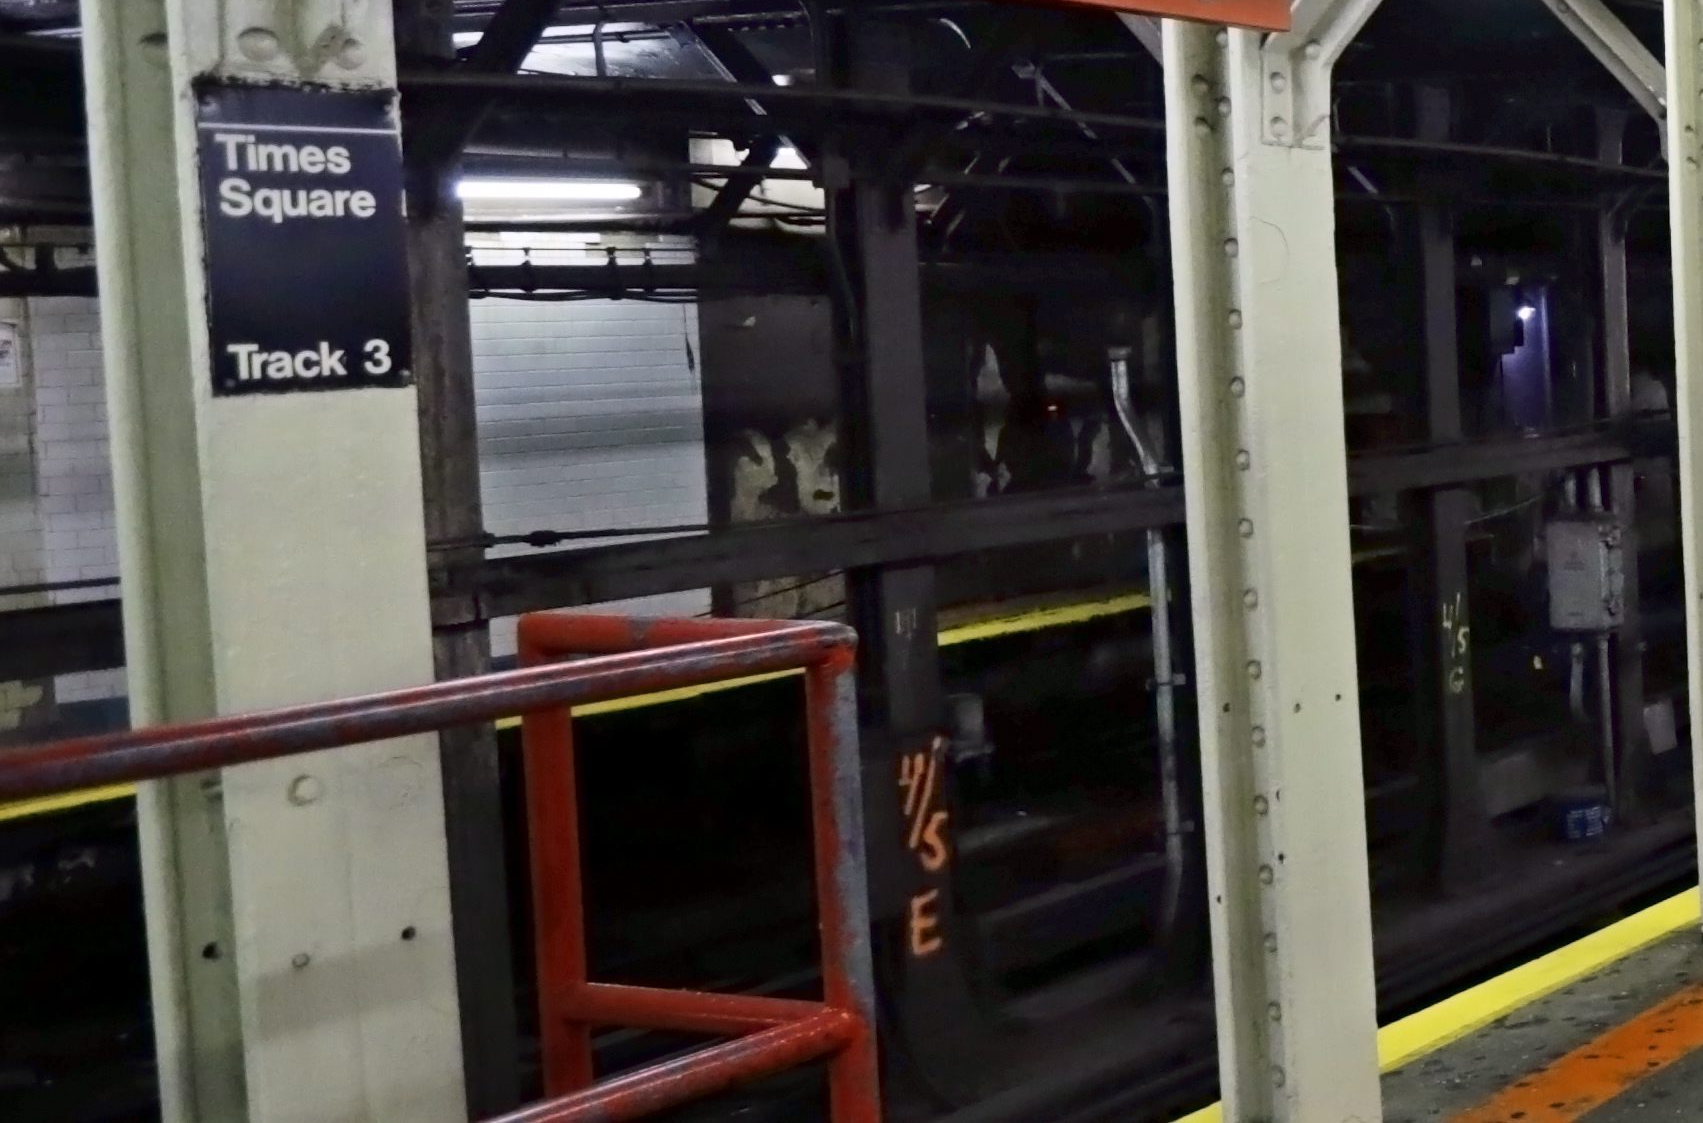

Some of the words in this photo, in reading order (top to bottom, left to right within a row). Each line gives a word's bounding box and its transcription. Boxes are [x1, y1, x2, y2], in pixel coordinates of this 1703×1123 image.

[214, 133, 352, 175] Times
[218, 177, 377, 224] Square
[226, 341, 347, 381] Track
[363, 338, 392, 375] 3
[909, 887, 944, 958] E
